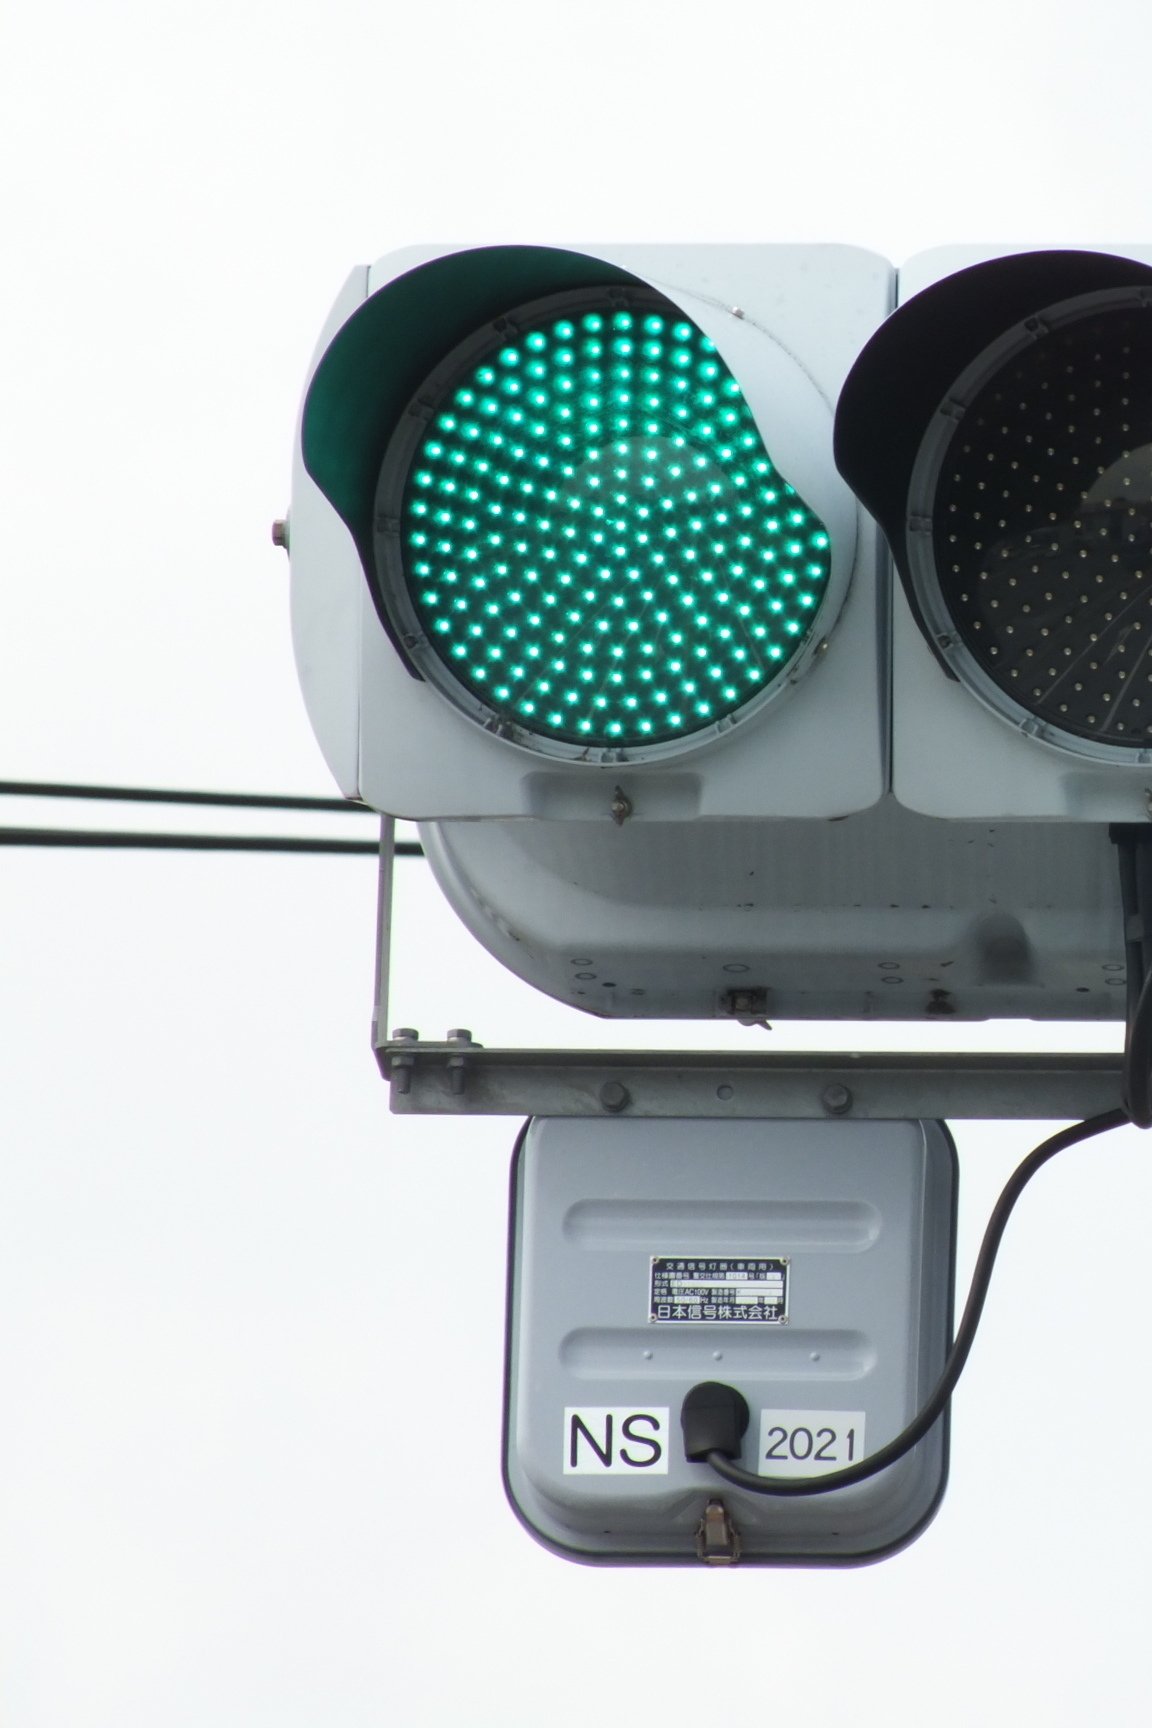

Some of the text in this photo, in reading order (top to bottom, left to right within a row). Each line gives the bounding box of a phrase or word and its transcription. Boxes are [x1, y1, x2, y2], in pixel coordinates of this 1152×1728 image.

[657, 1304, 779, 1320] 日本信号株式会社
[570, 1413, 662, 1468] NS
[765, 1426, 855, 1462] 2021
